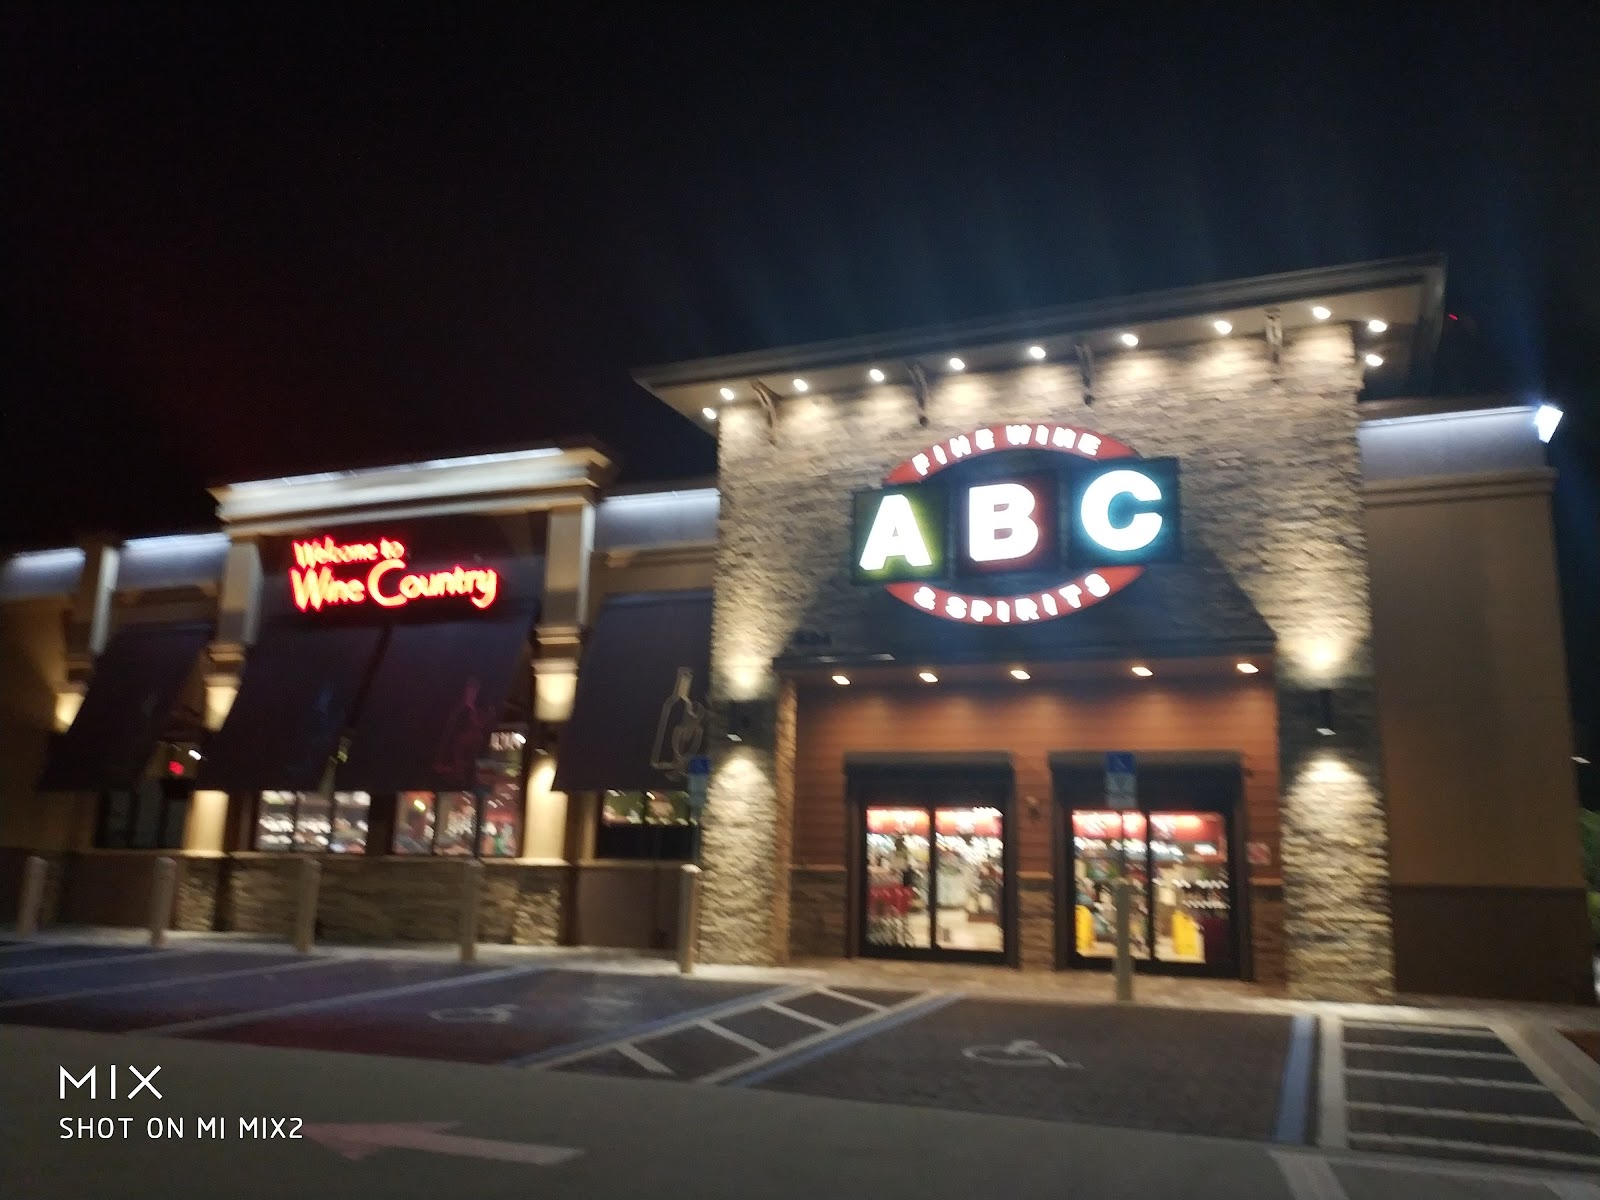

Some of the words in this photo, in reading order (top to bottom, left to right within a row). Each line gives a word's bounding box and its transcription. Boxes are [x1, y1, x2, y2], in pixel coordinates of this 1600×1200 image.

[911, 427, 996, 477] FINE
[1005, 424, 1102, 456] WINE
[858, 469, 1163, 571] ABC
[293, 535, 379, 569] Welcome
[379, 536, 405, 560] to
[290, 565, 366, 612] Wine
[367, 558, 498, 609] Country
[945, 573, 1111, 623] SPIRITS
